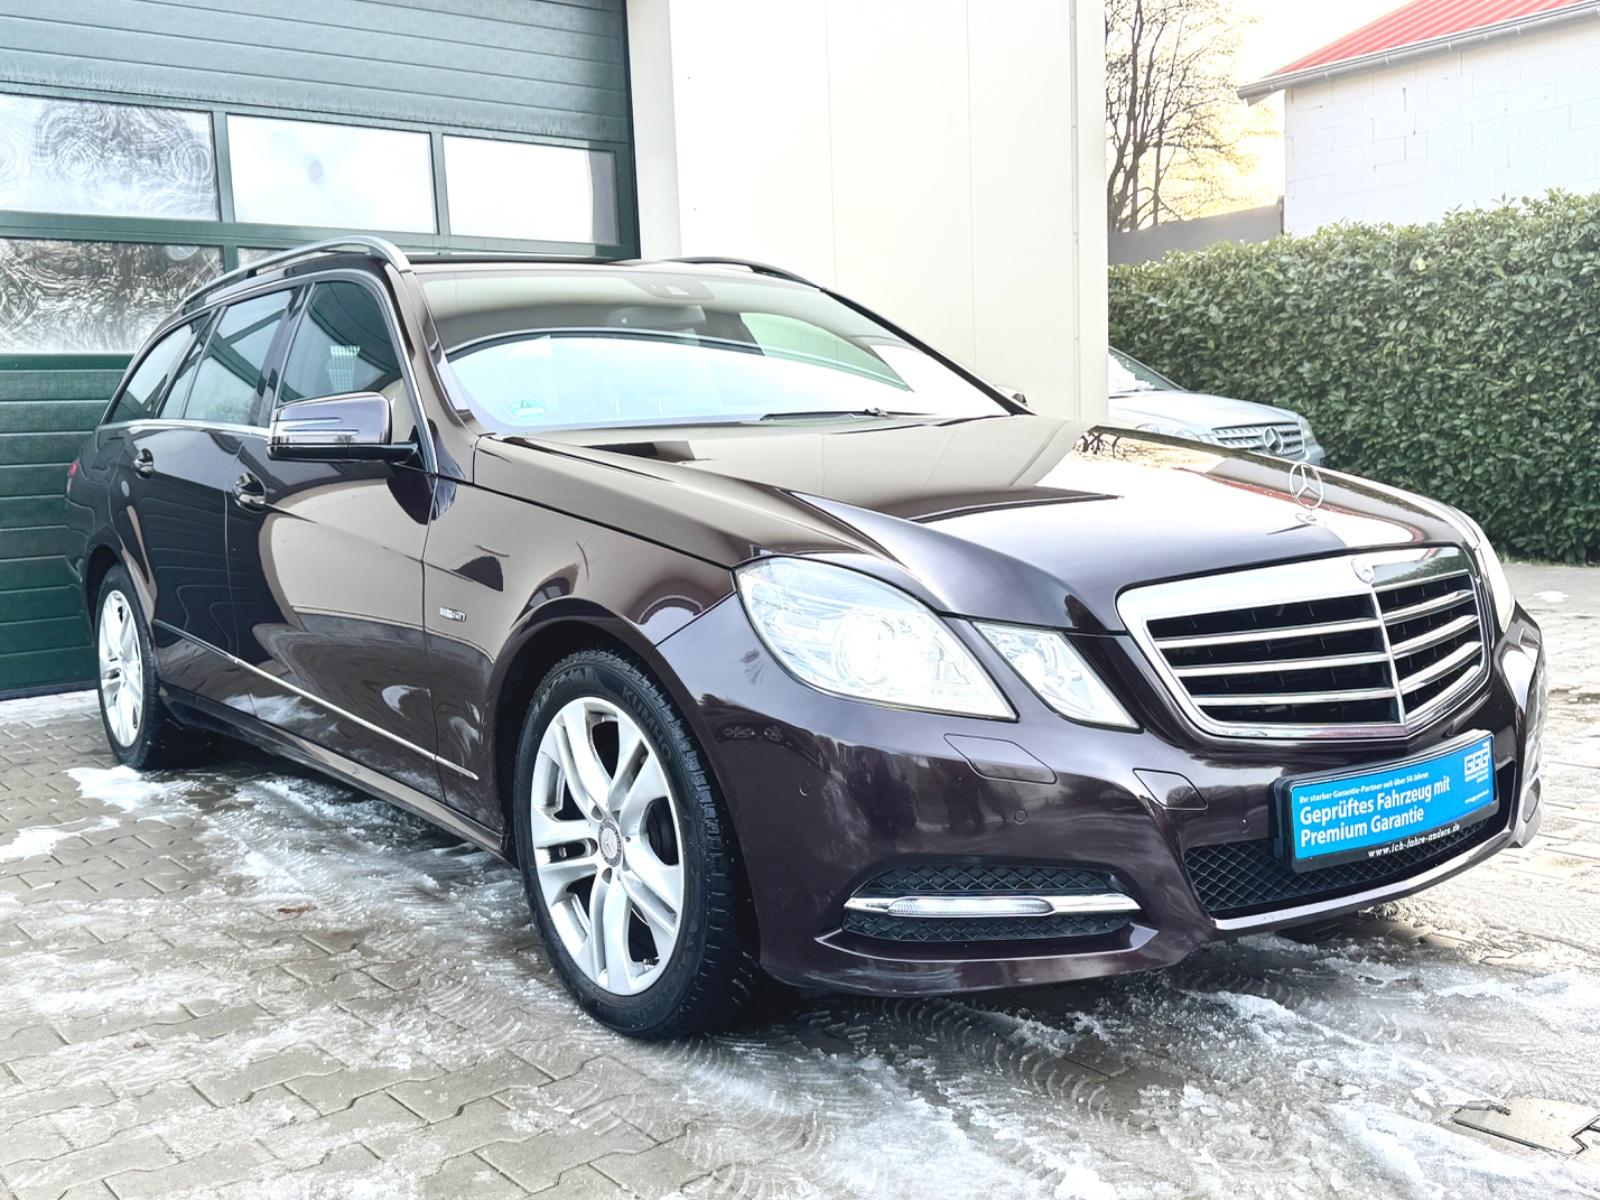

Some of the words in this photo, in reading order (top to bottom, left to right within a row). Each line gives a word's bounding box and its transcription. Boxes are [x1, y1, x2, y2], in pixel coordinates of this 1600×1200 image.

[622, 686, 672, 760] KUMHO
[1299, 795, 1309, 804] Ihr
[1310, 791, 1332, 802] starker
[1300, 797, 1374, 827] Geprüftes
[1377, 784, 1432, 812] Fahrzeug
[1434, 775, 1451, 796] mit
[1301, 817, 1367, 848] Premium
[1371, 806, 1424, 833] Garantie
